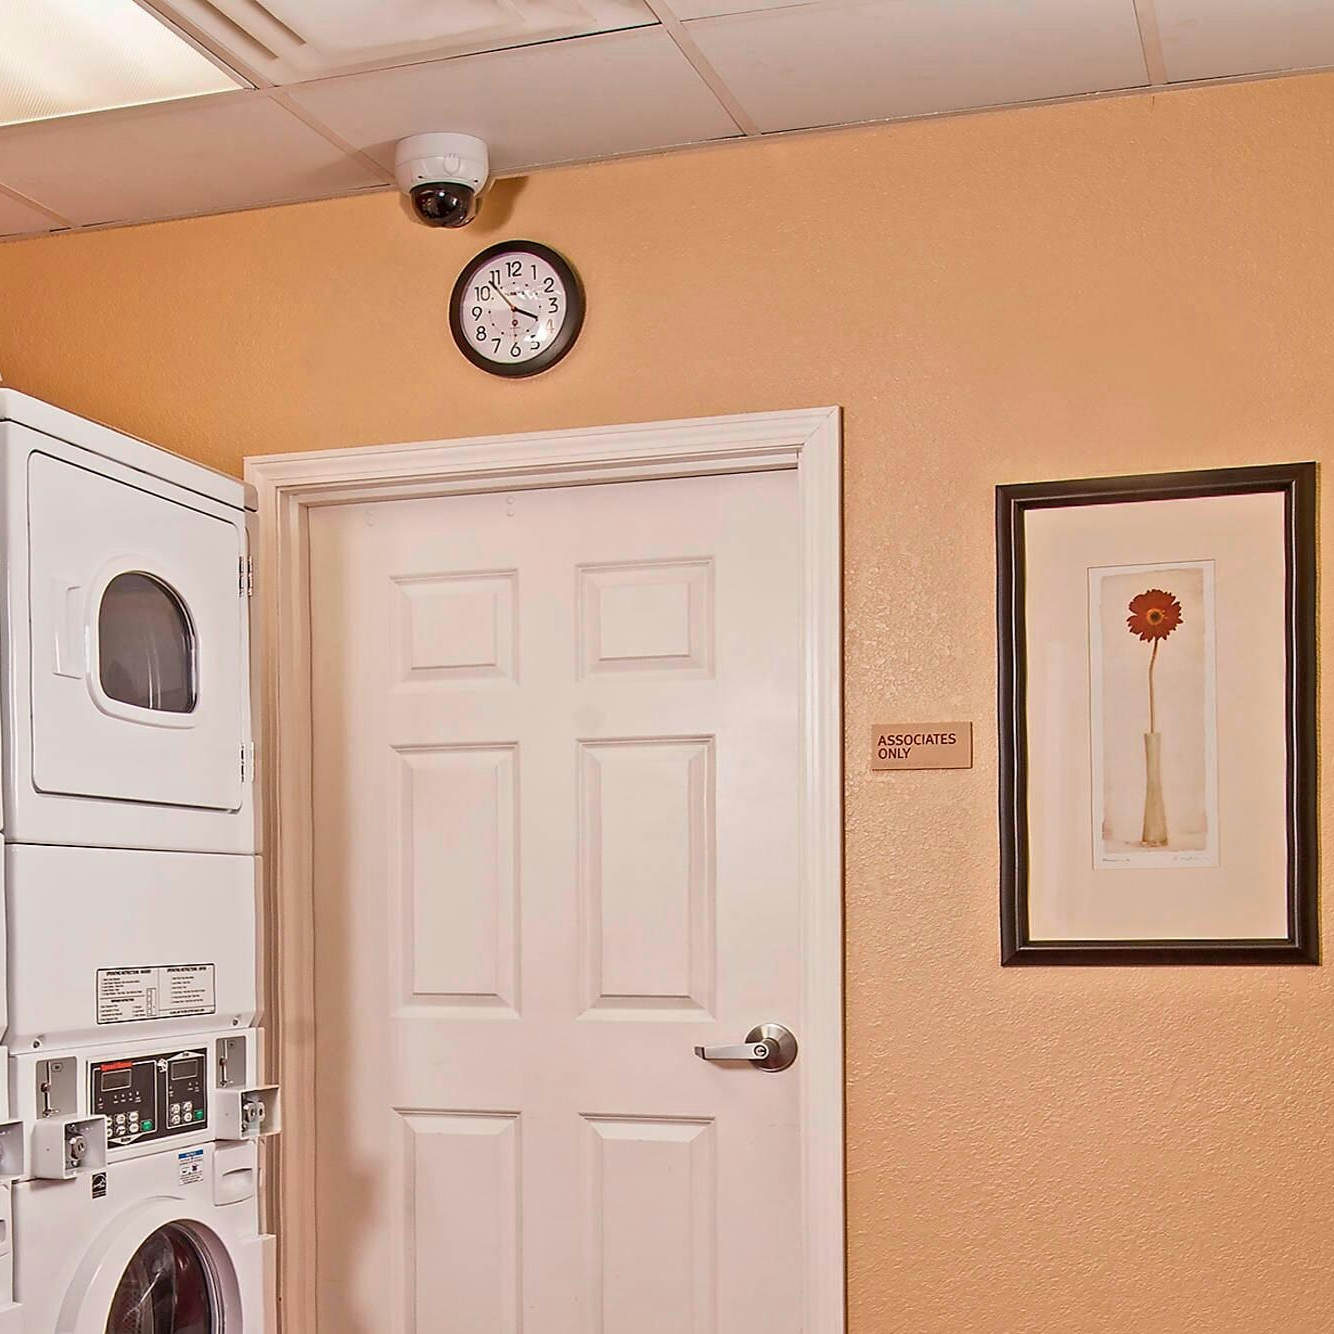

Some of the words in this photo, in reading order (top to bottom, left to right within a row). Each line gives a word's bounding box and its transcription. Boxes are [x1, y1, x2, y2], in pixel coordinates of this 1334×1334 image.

[505, 261, 522, 277] 12
[530, 265, 537, 280] 1
[489, 270, 501, 286] 11
[543, 277, 555, 293] 2
[474, 286, 491, 301] 10
[548, 297, 559, 313] 3
[471, 306, 483, 321] 9
[476, 326, 487, 341] 8
[547, 319, 555, 333] 4
[491, 338, 501, 353] 7
[510, 342, 522, 357] 6
[877, 733, 957, 746] ASSOCIATES
[878, 747, 911, 759] ONLY
